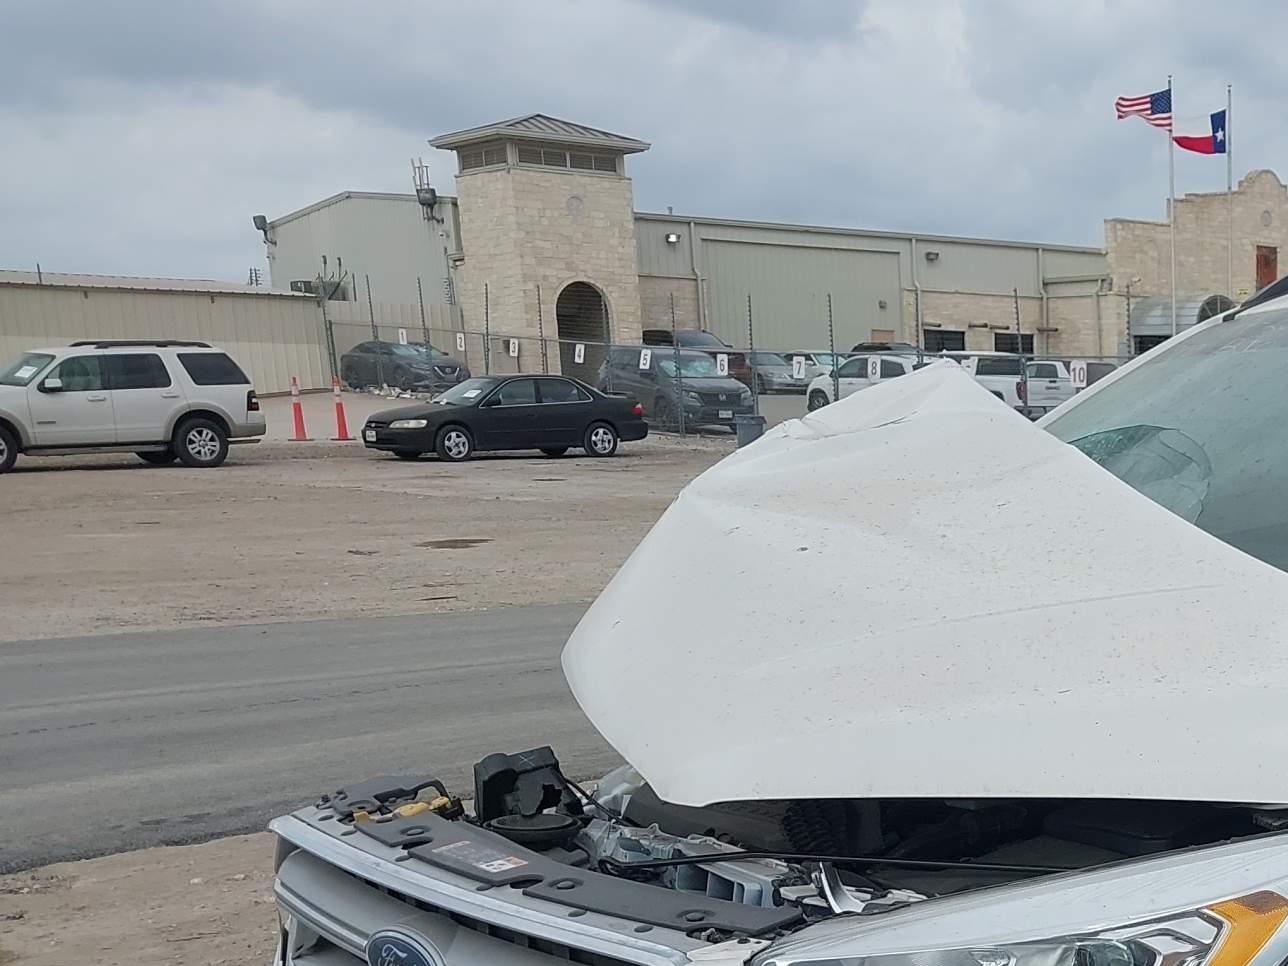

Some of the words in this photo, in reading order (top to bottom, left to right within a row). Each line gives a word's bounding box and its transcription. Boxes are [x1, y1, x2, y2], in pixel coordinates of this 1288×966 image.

[642, 353, 649, 367] 5
[719, 359, 725, 372] 6
[796, 361, 803, 375] 7
[871, 361, 877, 375] 8
[1072, 366, 1086, 384] 10
